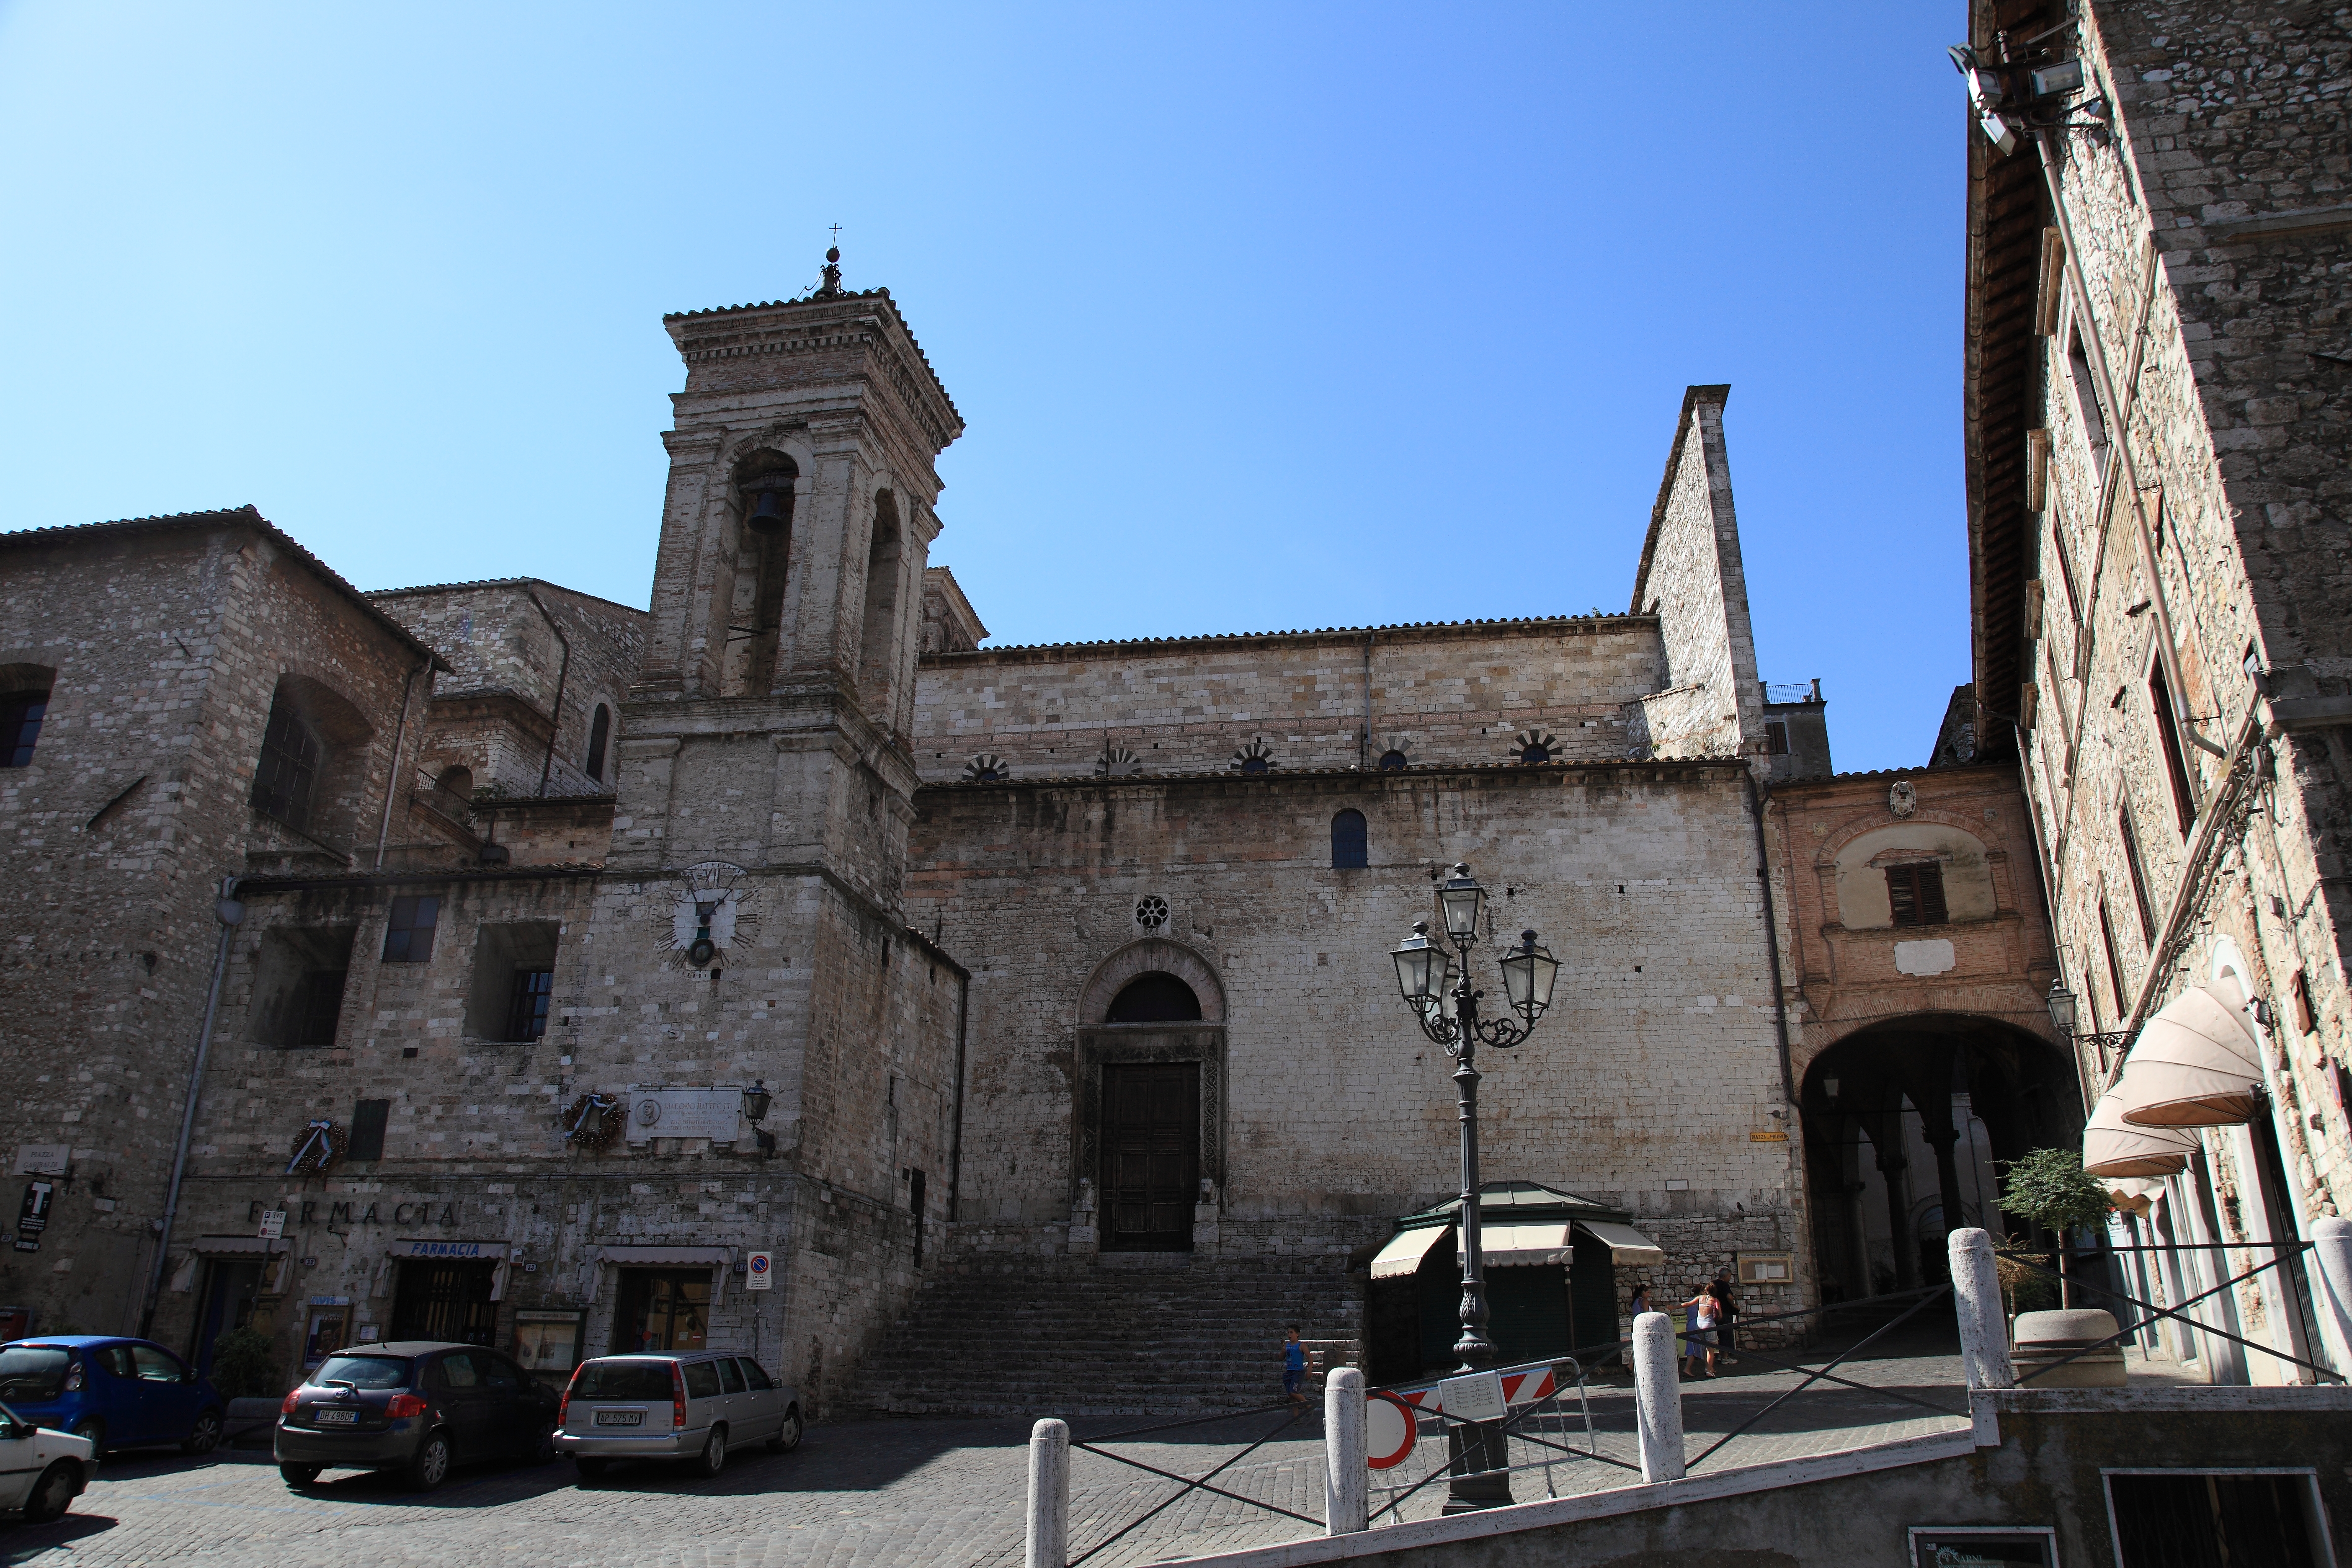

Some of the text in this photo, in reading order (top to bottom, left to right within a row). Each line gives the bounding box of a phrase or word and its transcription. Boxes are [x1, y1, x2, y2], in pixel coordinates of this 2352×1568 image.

[411, 1243, 479, 1255] FARMACIA
[320, 1410, 355, 1421] DH 498DF
